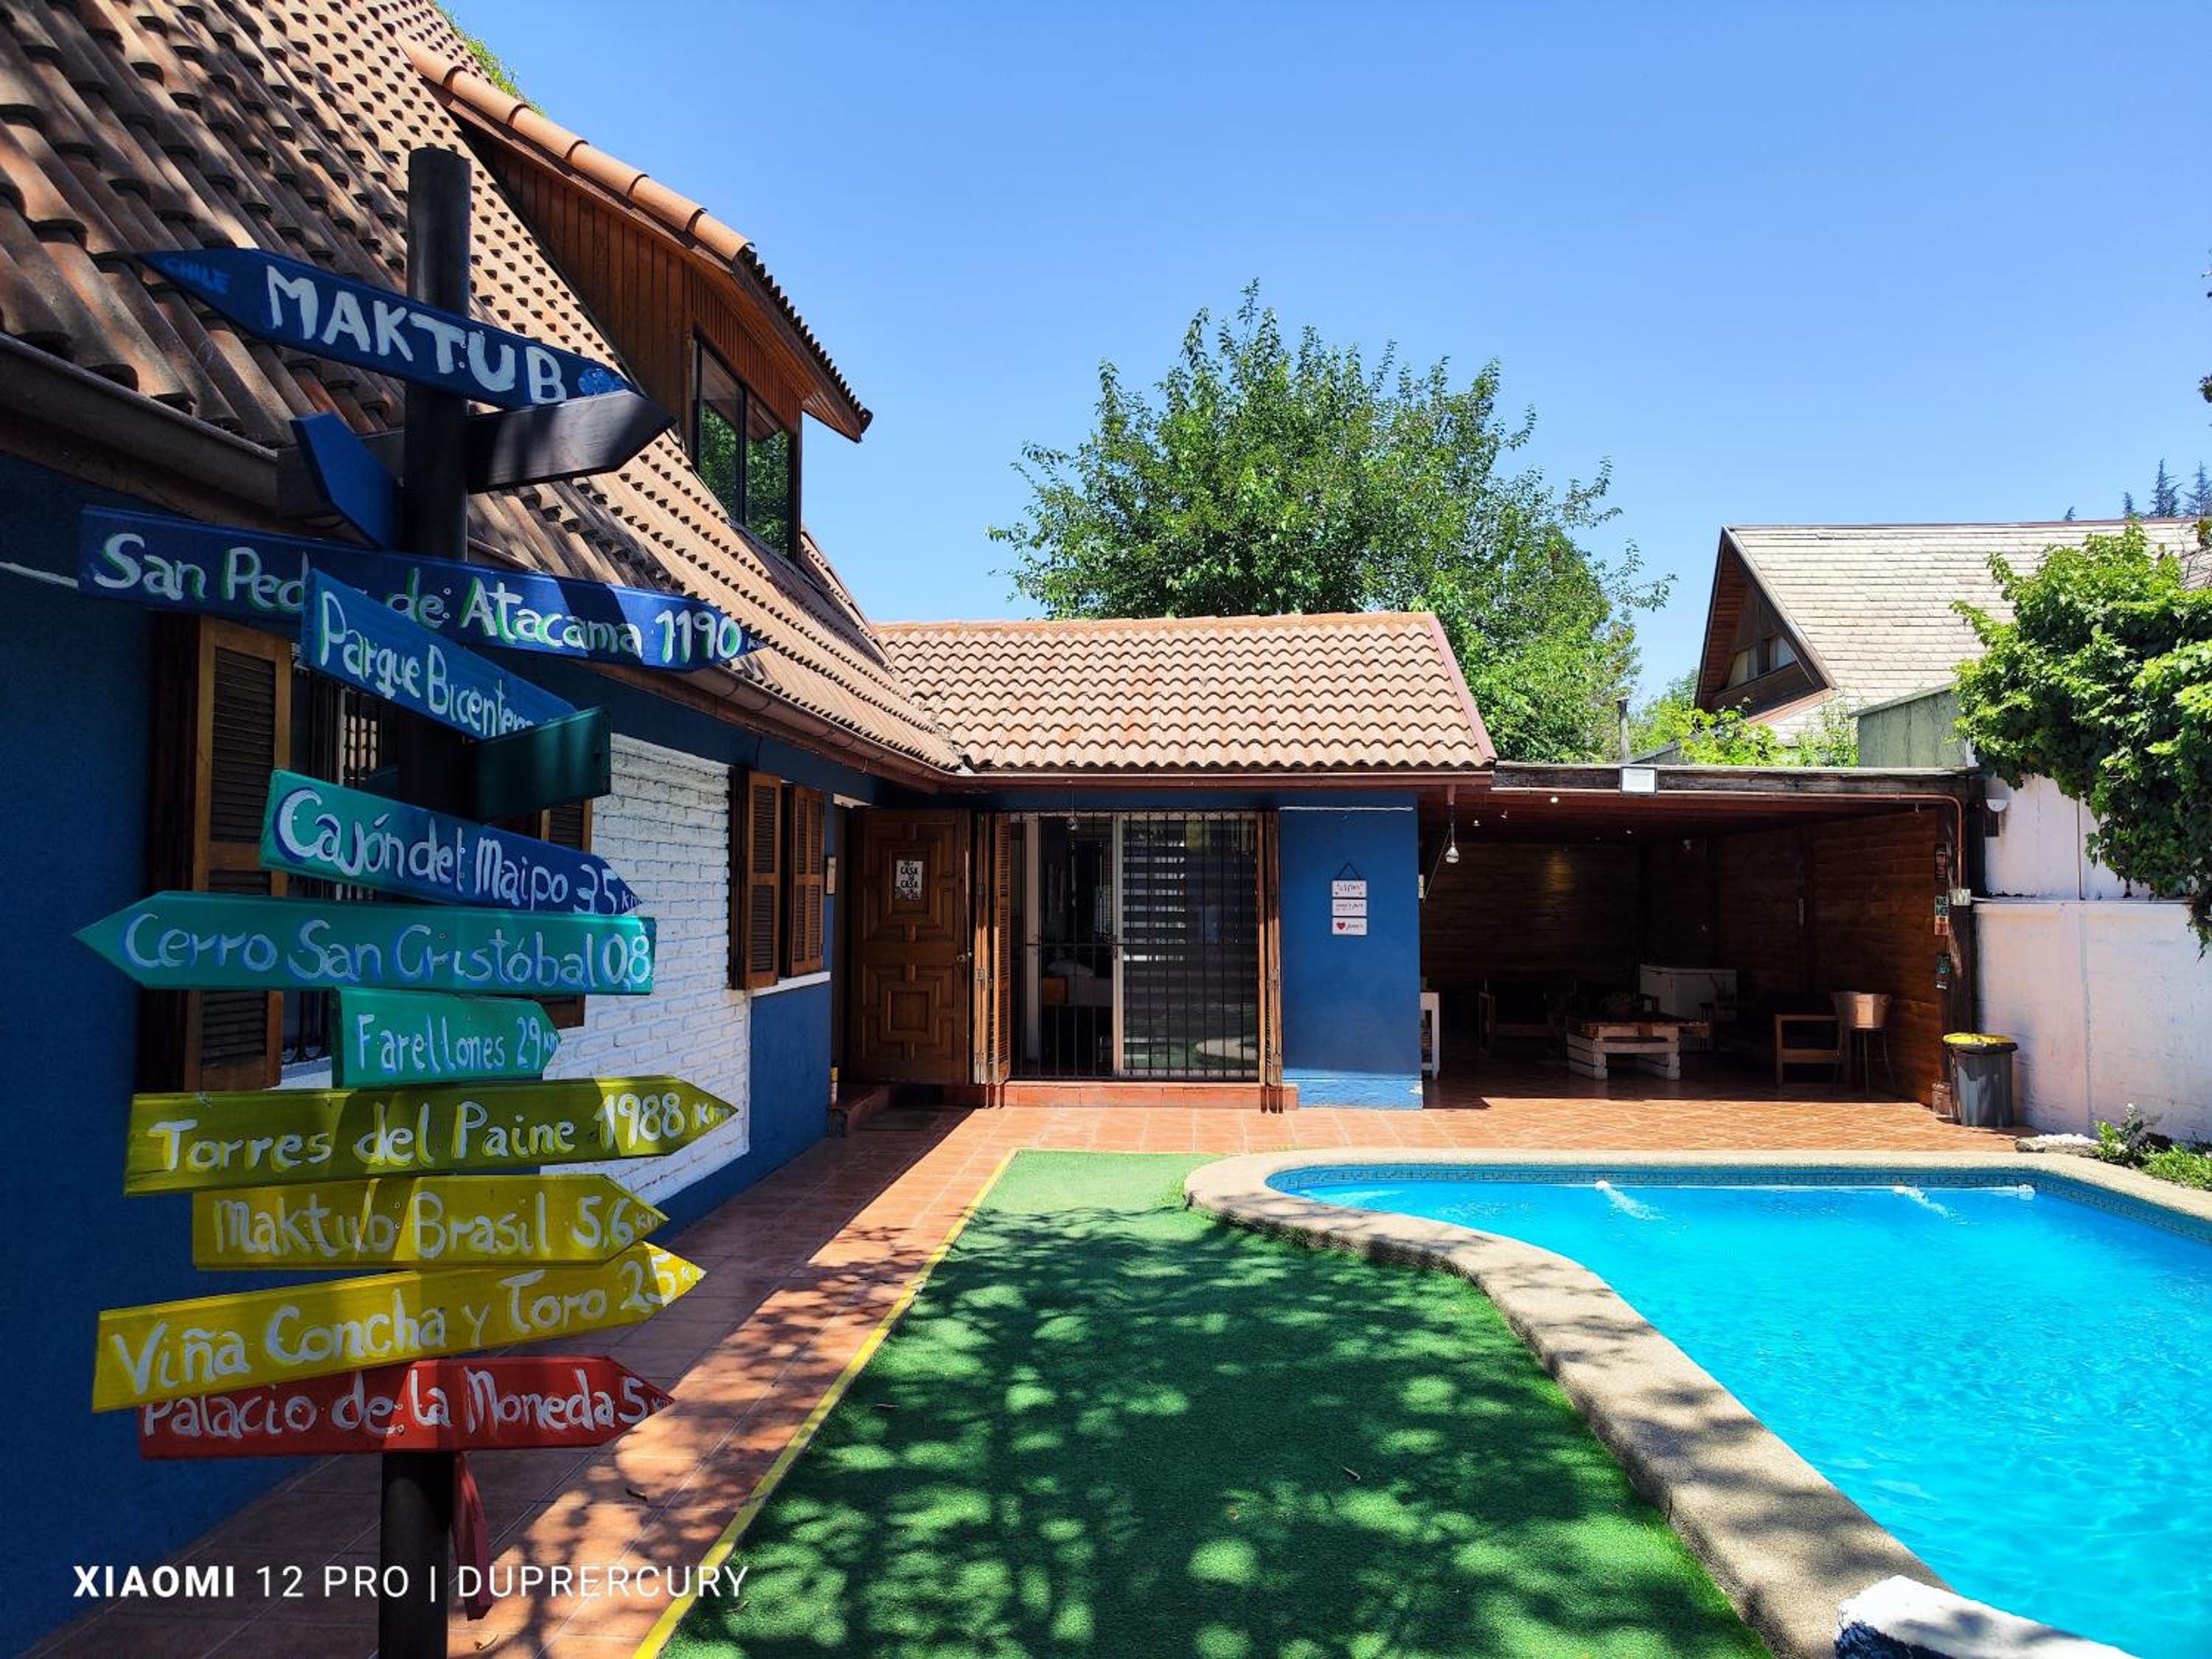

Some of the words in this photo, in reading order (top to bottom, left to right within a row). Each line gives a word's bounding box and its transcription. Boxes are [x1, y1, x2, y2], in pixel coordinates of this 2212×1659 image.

[266, 265, 567, 406] MAKTUB
[93, 532, 206, 602] San
[223, 546, 310, 613] Ped
[384, 566, 443, 627] de
[460, 576, 643, 659] Atacama
[655, 609, 742, 662] 1190
[320, 590, 421, 699] Parque
[408, 817, 464, 892] del
[475, 836, 568, 912] Maipo
[574, 863, 618, 914] 35
[122, 913, 278, 973] Cerro
[287, 919, 383, 982] San
[394, 923, 598, 987] Cristóbal
[357, 1014, 507, 1073] Farellones
[518, 1016, 541, 1069] 29
[149, 1119, 332, 1172] Torres
[352, 1102, 435, 1166] del
[451, 1101, 576, 1158] Paine
[593, 1092, 684, 1152] 1988
[214, 1192, 396, 1258] Maktub
[413, 1192, 552, 1258] Brasil
[111, 1321, 253, 1396] Viña
[265, 1287, 448, 1364] Concha
[461, 1304, 491, 1345] y
[498, 1269, 608, 1333] Toro
[143, 1385, 318, 1439] Palacio
[331, 1372, 396, 1436] de
[463, 1366, 615, 1435] Moneda
[618, 1376, 648, 1422] 5
